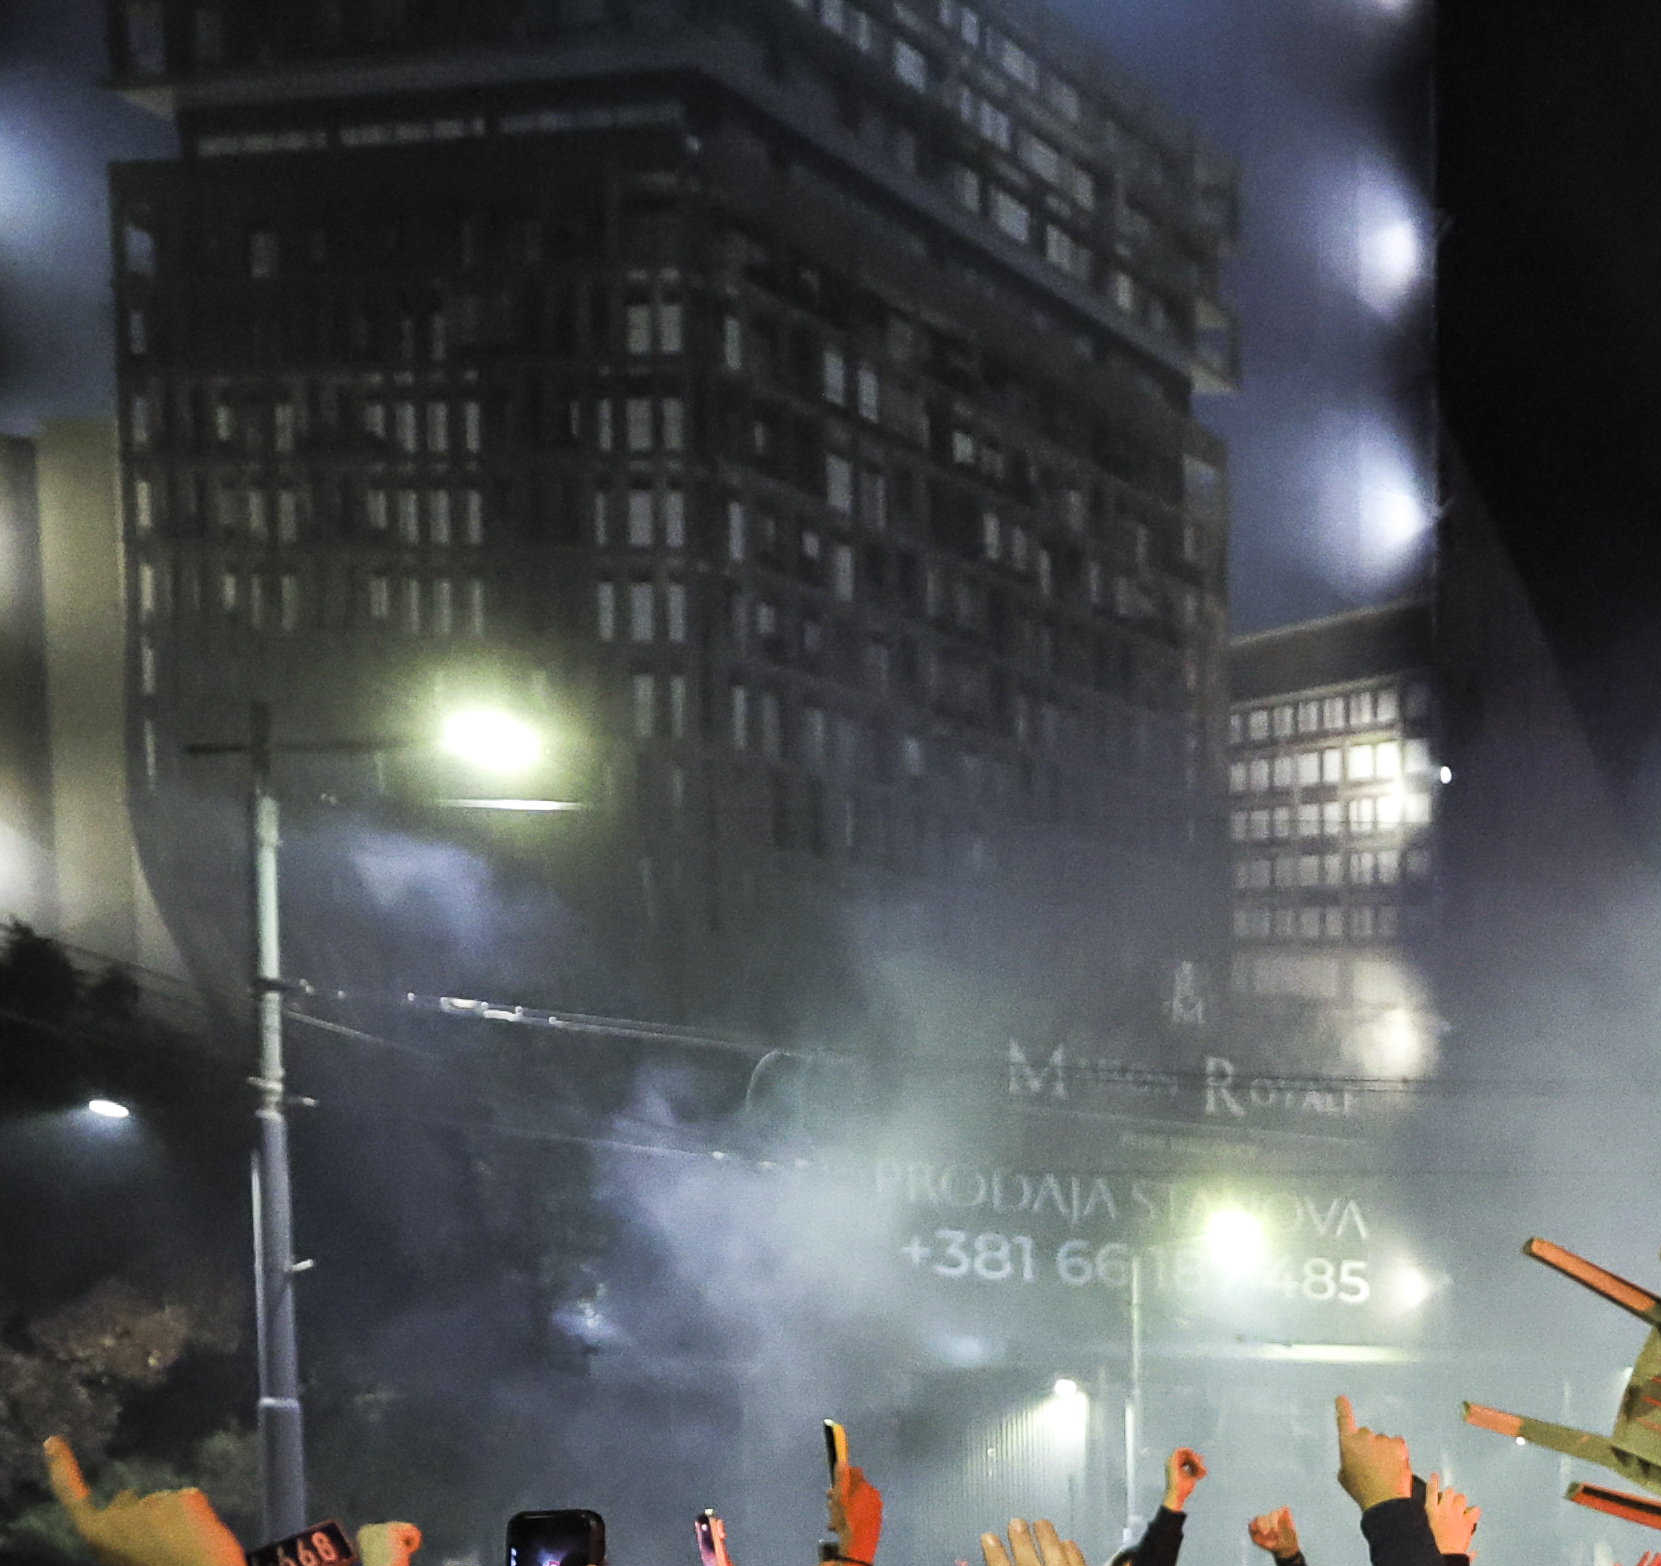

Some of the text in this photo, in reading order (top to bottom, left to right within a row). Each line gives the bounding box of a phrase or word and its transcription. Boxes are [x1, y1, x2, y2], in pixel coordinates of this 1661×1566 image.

[876, 1158, 1369, 1240] PRODAJA STAOVA
[901, 1229, 1037, 1283] +381
[1055, 1238, 1130, 1287] 66
